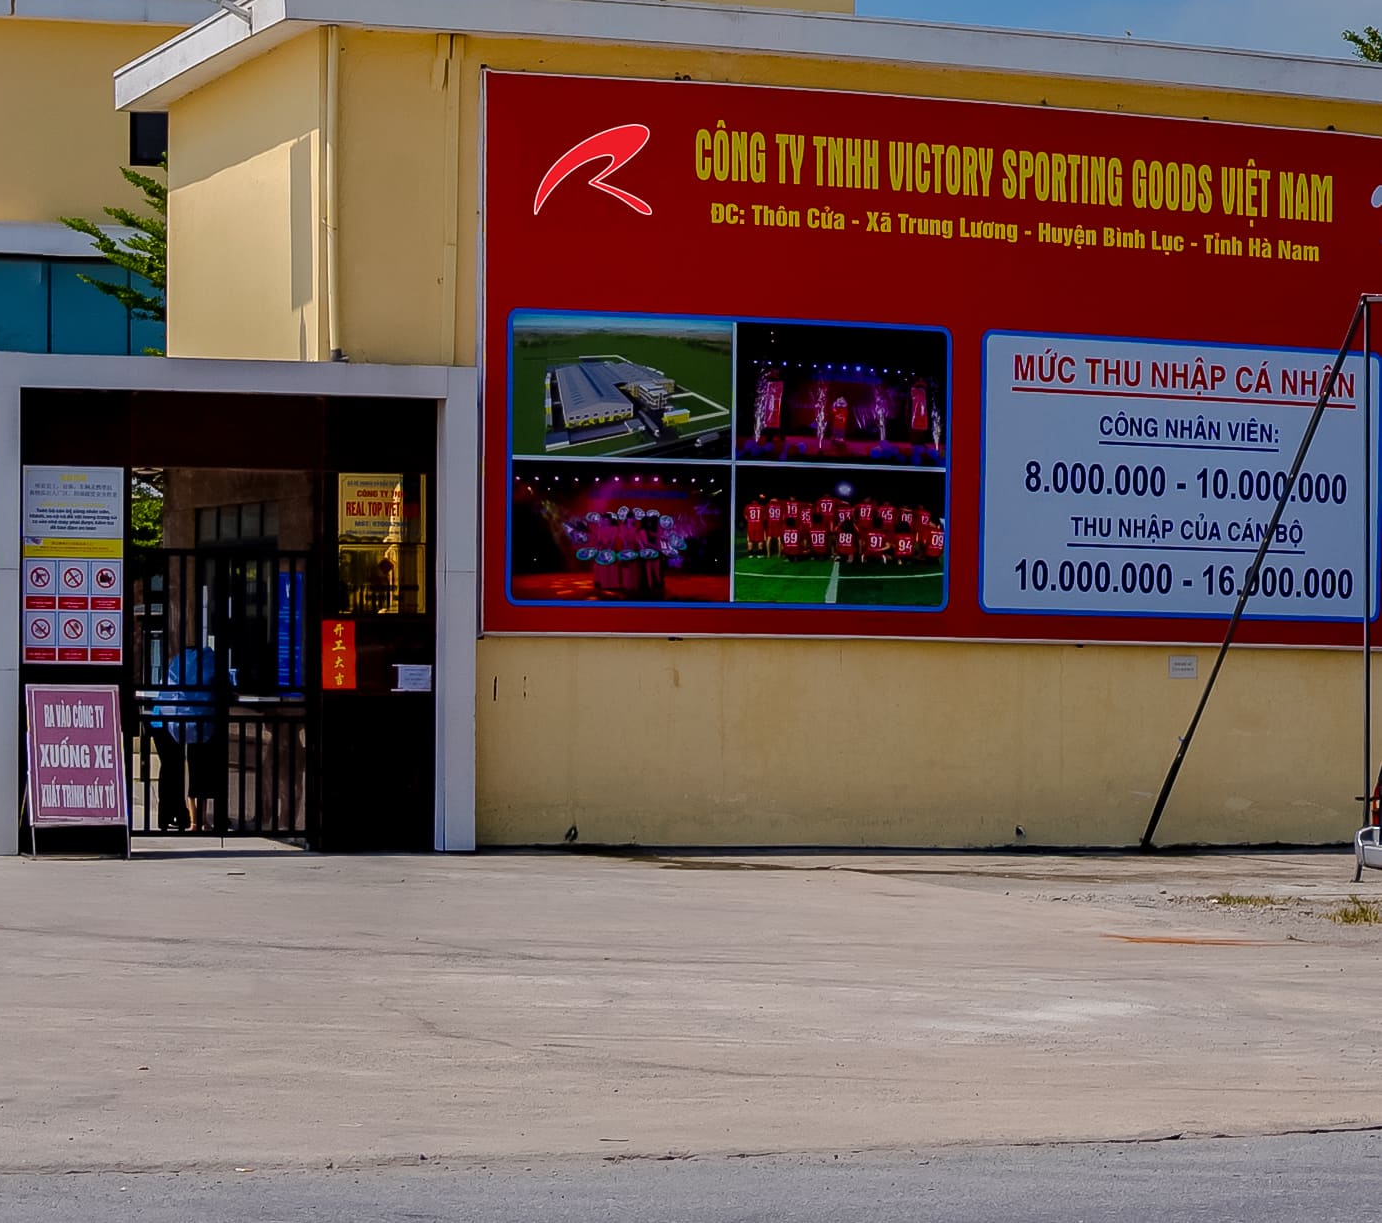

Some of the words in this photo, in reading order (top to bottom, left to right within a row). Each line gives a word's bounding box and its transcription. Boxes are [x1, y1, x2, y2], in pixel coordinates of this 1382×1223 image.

[695, 119, 766, 183] CÔNG
[775, 133, 805, 185] TY
[812, 135, 879, 190] TNHH
[888, 140, 994, 197] VICTORY
[1002, 149, 1123, 207] SPORTING
[1132, 159, 1213, 214] GOODS
[1221, 158, 1271, 227] VIỆT
[1279, 171, 1333, 223] NAM
[710, 202, 745, 225] ĐC:
[751, 204, 800, 227] Thôn
[807, 205, 845, 230] Cửa
[866, 210, 892, 233] Xã
[897, 213, 953, 239] Trung
[959, 217, 1018, 243] Lương
[1038, 222, 1097, 249] Huyện
[1103, 226, 1145, 249] Bình
[1151, 230, 1184, 256] Lục
[1203, 232, 1243, 257] Tỉnh
[1249, 238, 1272, 259] Hà
[1278, 240, 1320, 262] Nam
[1013, 348, 1076, 384] MỨC
[1085, 357, 1141, 387] THU
[1150, 357, 1227, 396] NHẬP
[1235, 361, 1273, 394] CÁ
[1099, 411, 1159, 438] CÔNG
[1165, 414, 1221, 441] NHÂN
[1228, 417, 1280, 444] VIÊN:
[1024, 460, 1166, 497] 8.000.000
[1196, 468, 1348, 505] 10.000.000
[1070, 516, 1112, 538] THU
[1118, 514, 1174, 544] NHẬP
[1180, 513, 1222, 542] CỦA
[1228, 517, 1269, 542] CÁN
[1276, 520, 1303, 548] BỘ
[1014, 559, 1173, 595] 10.000.000
[43, 704, 55, 728] RA
[56, 700, 72, 728] VÀO
[95, 705, 104, 728] TY
[40, 736, 90, 768] XUỐNG
[94, 745, 113, 769] XE
